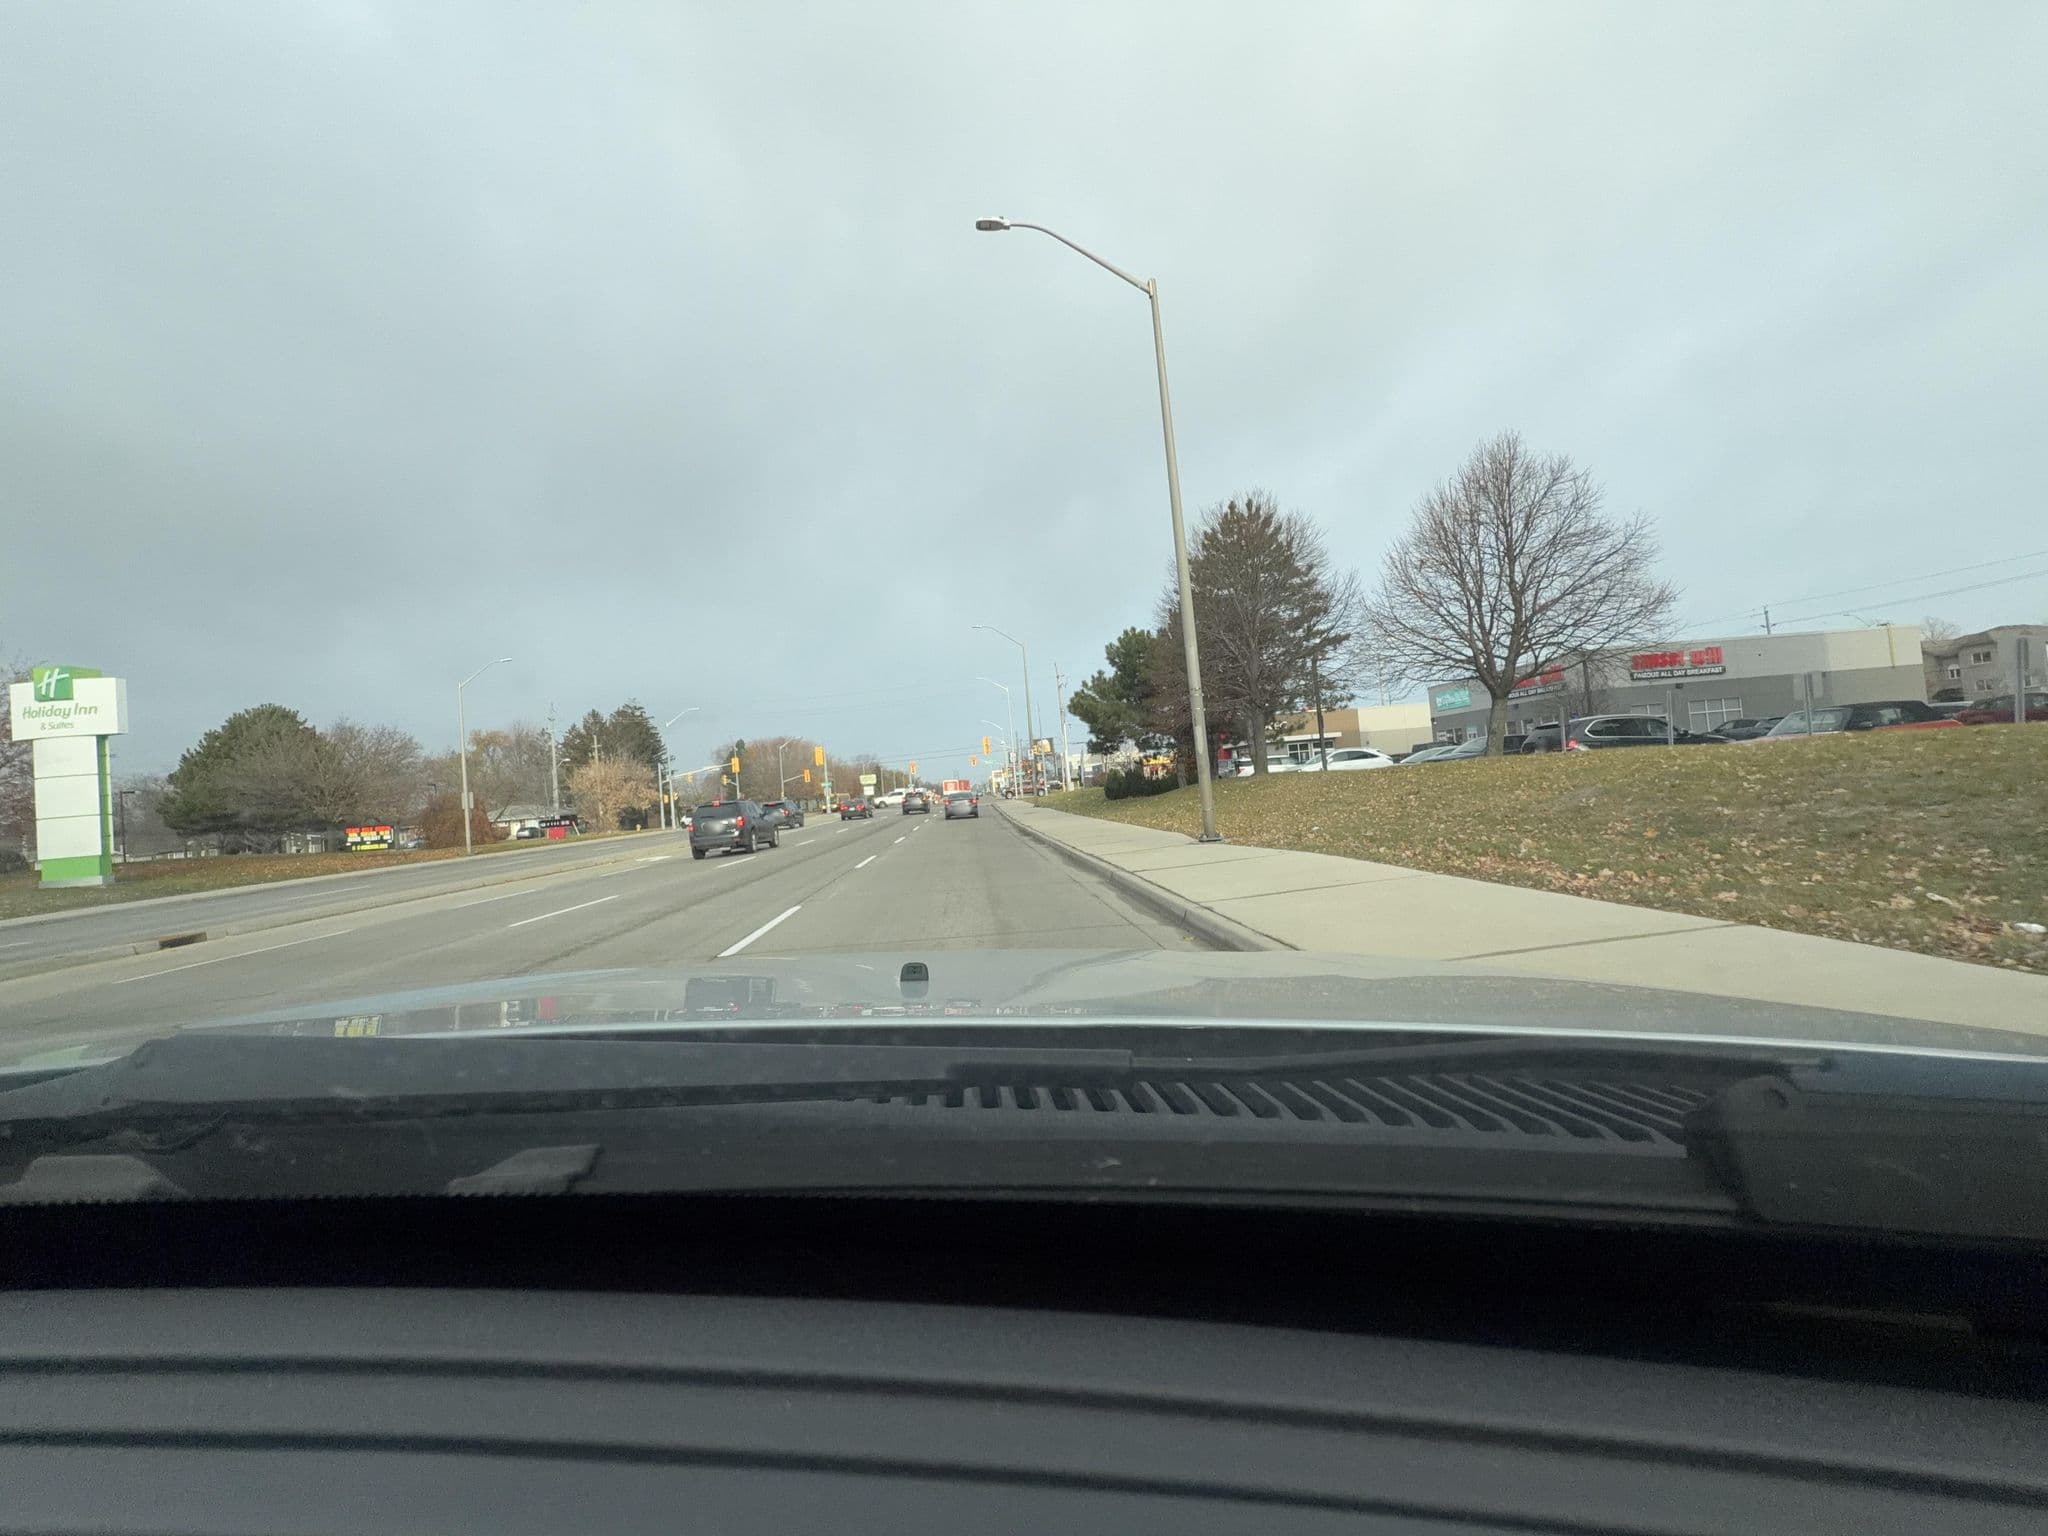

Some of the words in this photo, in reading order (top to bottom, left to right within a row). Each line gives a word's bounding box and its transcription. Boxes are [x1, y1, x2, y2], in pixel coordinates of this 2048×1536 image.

[1660, 670, 1673, 678] ALL
[1673, 669, 1687, 677] DAY
[1687, 667, 1723, 676] BREAKFAST
[22, 704, 71, 719] Holiday
[74, 703, 98, 716] Inn
[48, 721, 74, 730] Suites
